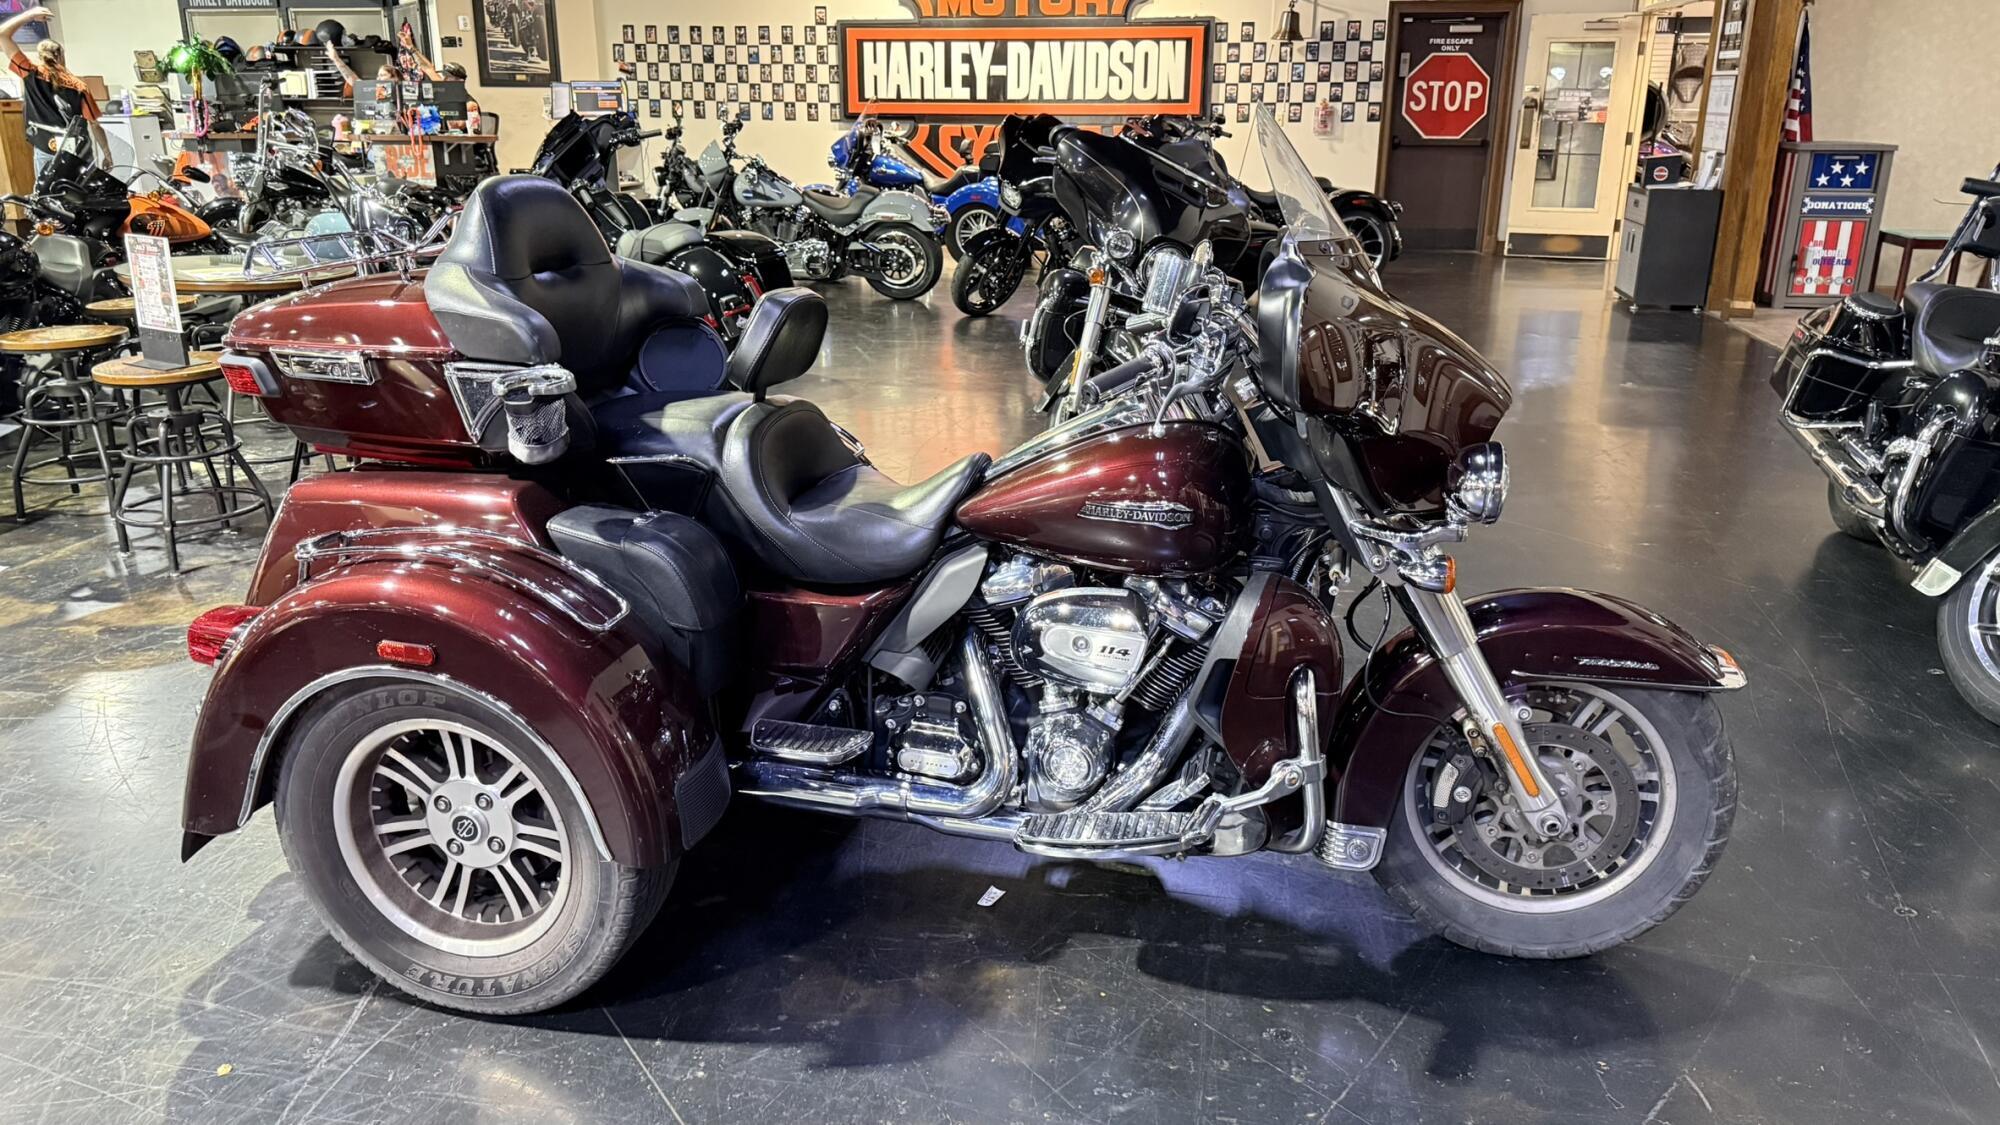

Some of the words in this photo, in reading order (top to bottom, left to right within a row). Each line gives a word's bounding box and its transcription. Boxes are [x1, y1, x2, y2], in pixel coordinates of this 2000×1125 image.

[862, 39, 1188, 101] HARLEY-DAVIDSON
[1409, 80, 1484, 112] STOP
[1807, 201, 1869, 210] DONATIONS
[1086, 504, 1191, 523] HARLEY-DAVIDSON
[1100, 645, 1131, 657] 114
